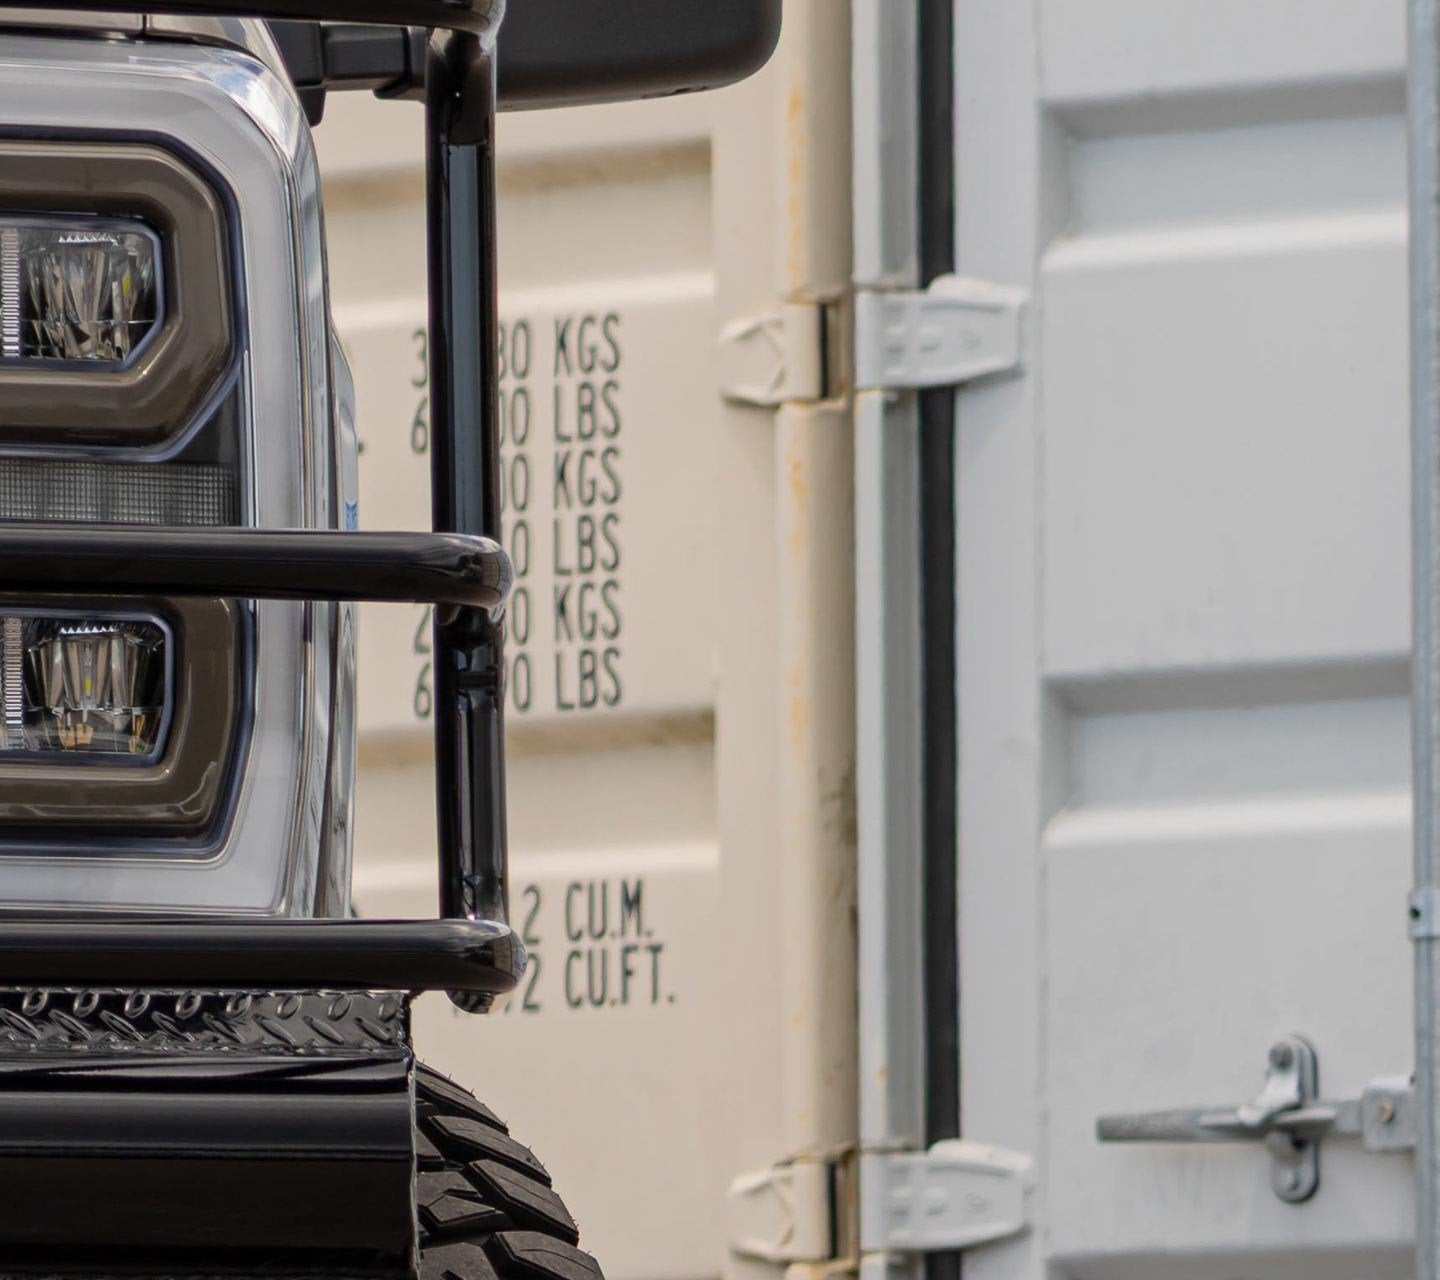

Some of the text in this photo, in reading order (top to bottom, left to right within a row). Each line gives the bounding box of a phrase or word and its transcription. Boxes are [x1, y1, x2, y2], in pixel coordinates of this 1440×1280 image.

[553, 312, 621, 378] KGS
[553, 379, 621, 443] LBS
[553, 446, 622, 511] KGS
[553, 512, 621, 576] LBS
[553, 578, 622, 643] KGS
[554, 646, 622, 712] LBS
